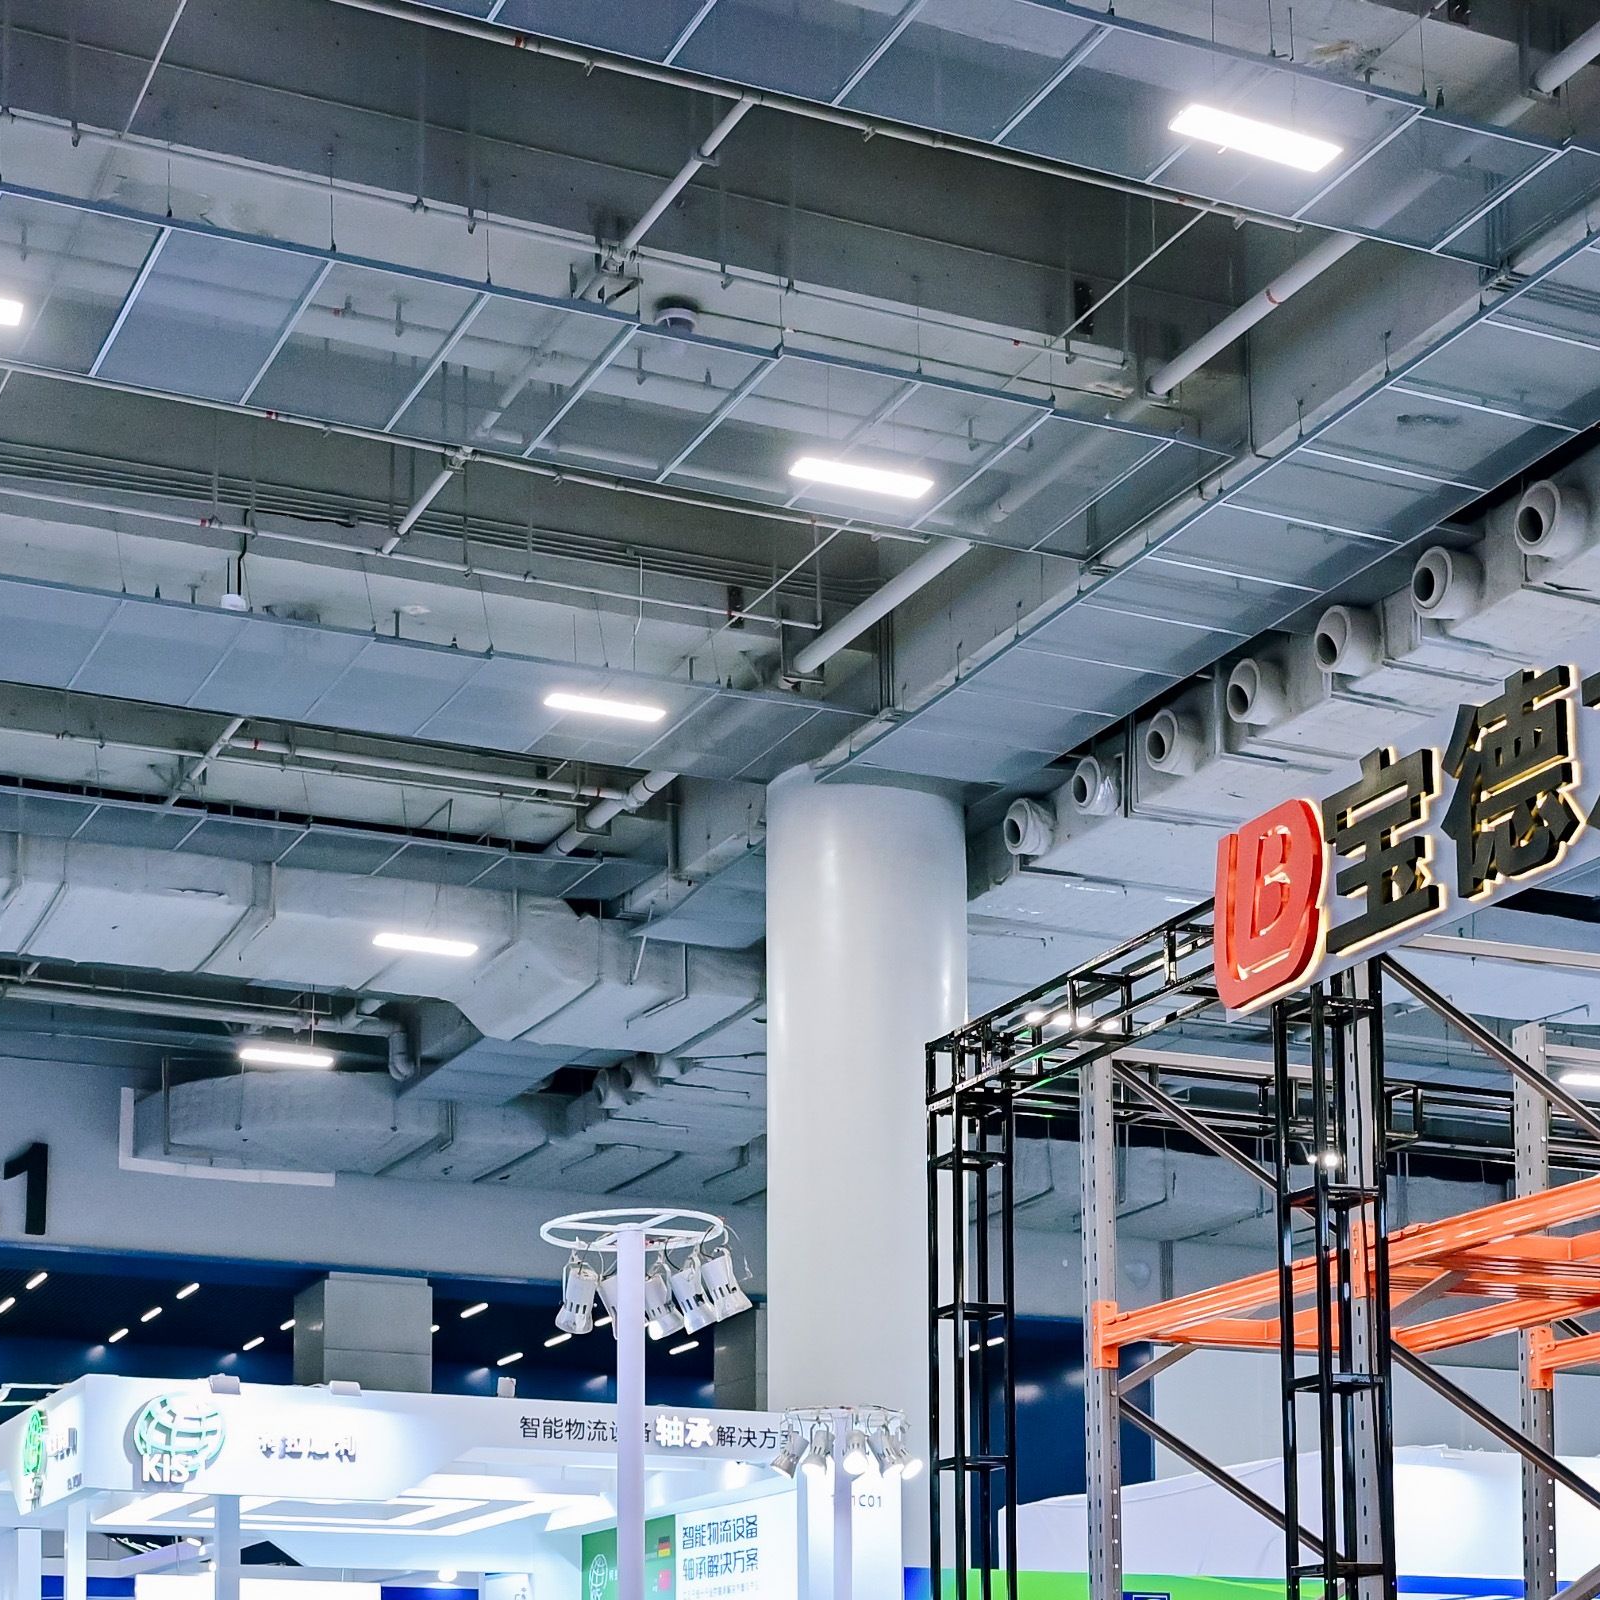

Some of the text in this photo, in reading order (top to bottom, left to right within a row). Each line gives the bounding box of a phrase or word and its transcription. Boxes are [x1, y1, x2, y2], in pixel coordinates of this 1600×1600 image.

[142, 1453, 192, 1484] KIS
[682, 1514, 759, 1550] 智能物流设备
[682, 1547, 760, 1582] 轴承解决方案
